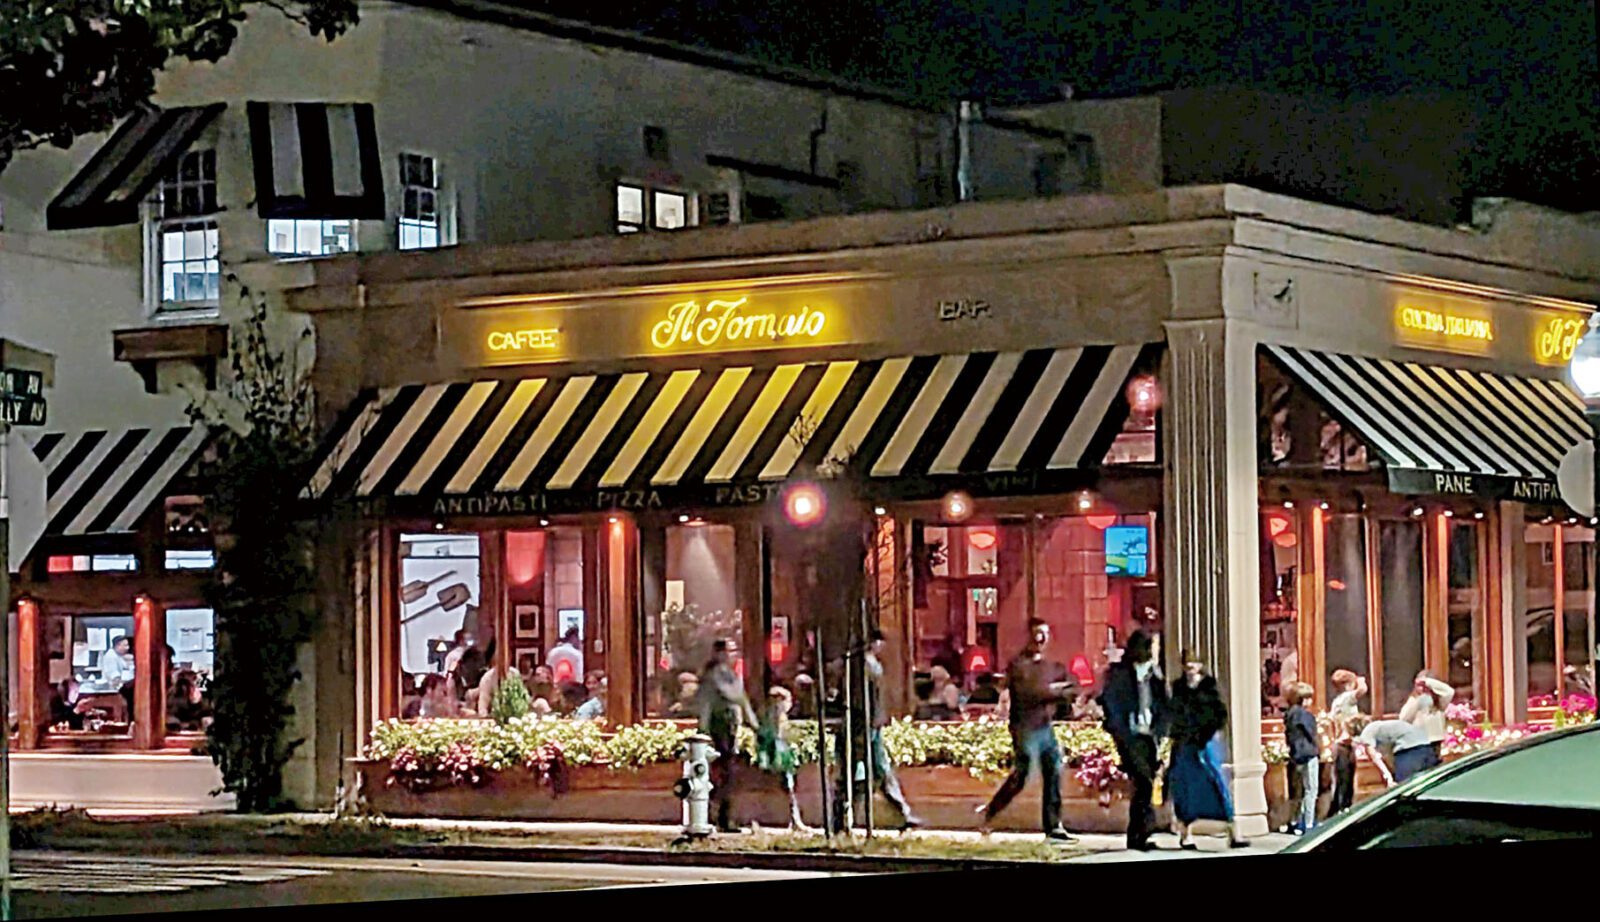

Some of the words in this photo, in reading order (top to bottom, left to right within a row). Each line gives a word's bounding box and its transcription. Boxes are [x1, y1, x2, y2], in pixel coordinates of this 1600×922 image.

[1434, 473, 1475, 493] PANE
[433, 494, 548, 514] ANTIPASTI
[596, 490, 663, 509] PIZZA
